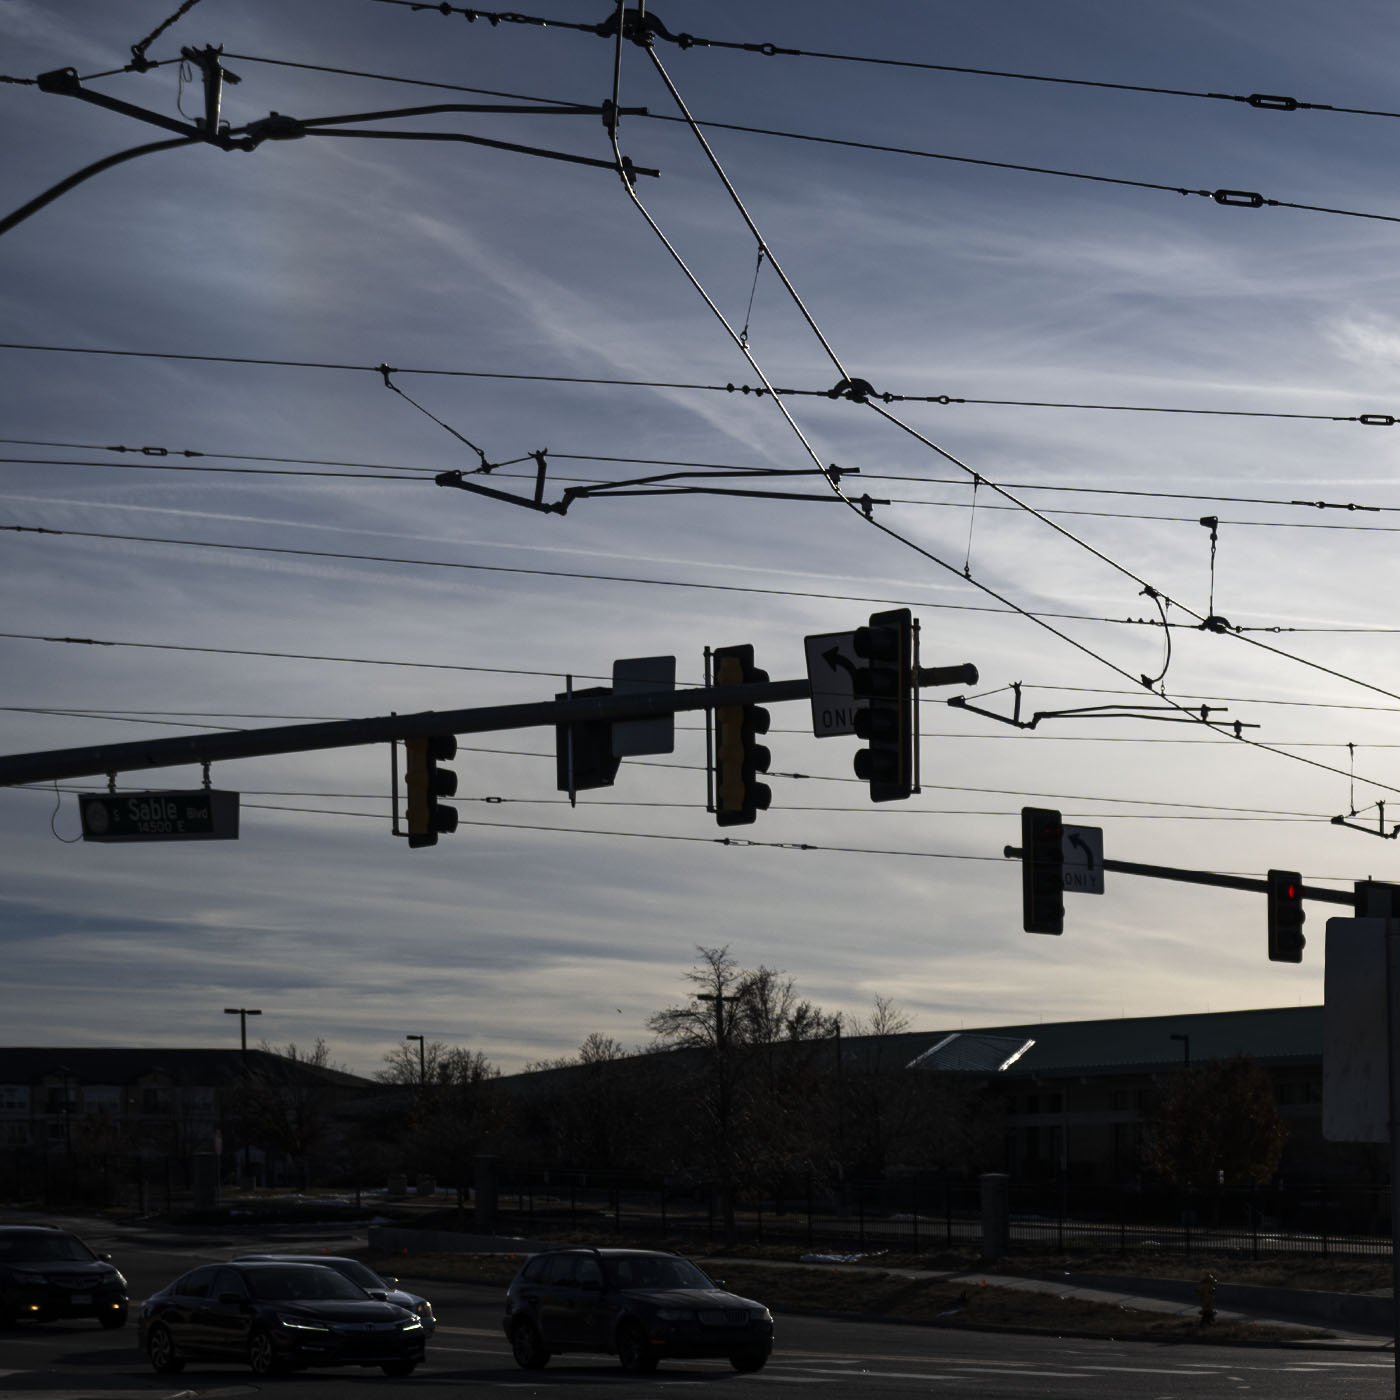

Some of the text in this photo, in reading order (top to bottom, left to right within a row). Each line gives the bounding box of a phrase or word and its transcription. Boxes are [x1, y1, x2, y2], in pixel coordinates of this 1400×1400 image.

[822, 708, 855, 728] ONL
[114, 798, 208, 822] S Sable Blvd
[138, 821, 185, 833] 14500 E
[1065, 872, 1097, 888] ONLY
